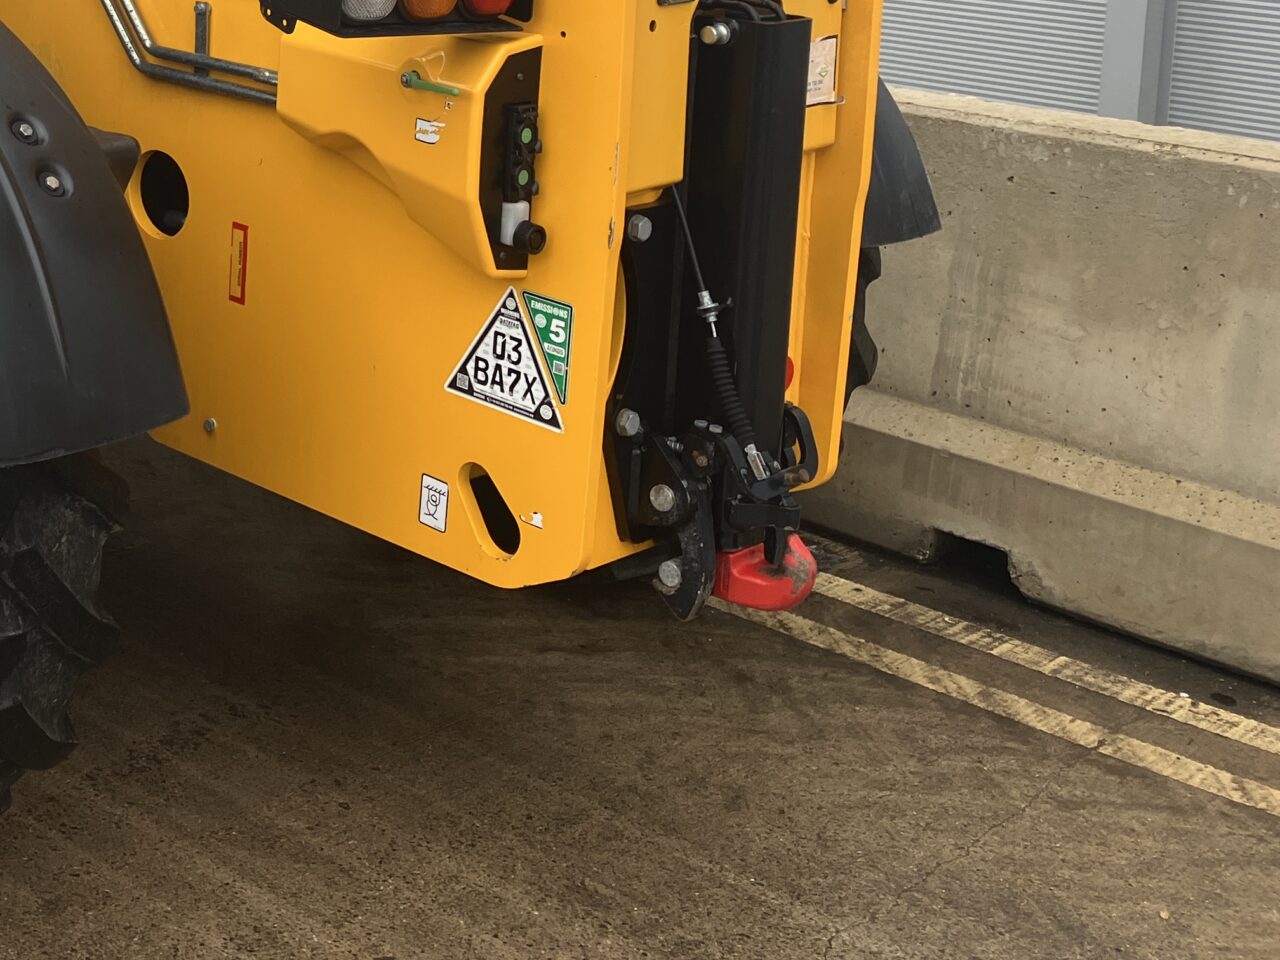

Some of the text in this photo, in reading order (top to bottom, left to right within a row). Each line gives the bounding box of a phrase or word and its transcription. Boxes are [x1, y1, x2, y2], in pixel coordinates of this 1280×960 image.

[492, 330, 523, 366] 03
[548, 318, 566, 343] 5
[472, 355, 538, 406] BA7X
